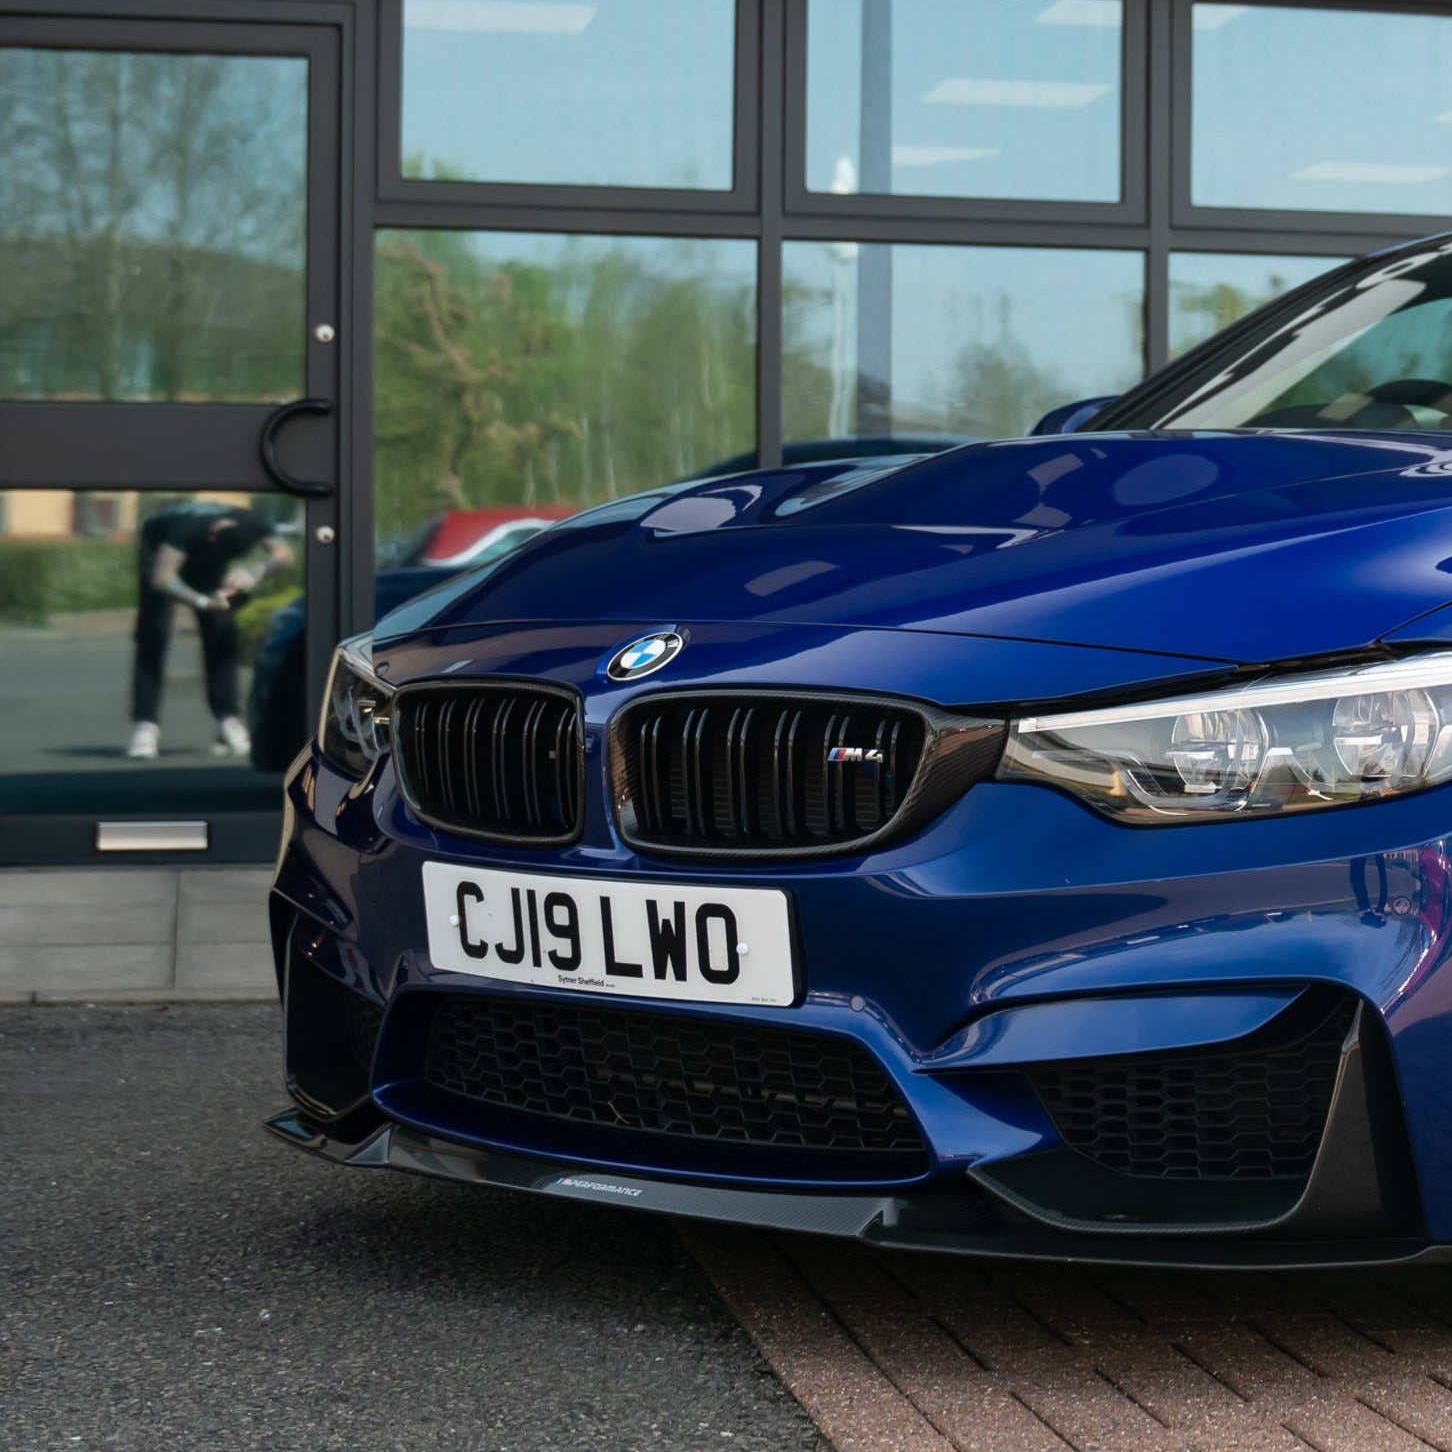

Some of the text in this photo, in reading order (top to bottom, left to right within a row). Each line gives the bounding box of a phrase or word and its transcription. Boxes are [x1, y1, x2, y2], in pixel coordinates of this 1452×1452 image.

[457, 881, 741, 985] CJ19 LWO
[558, 974, 605, 987] Sytner Sheffield
